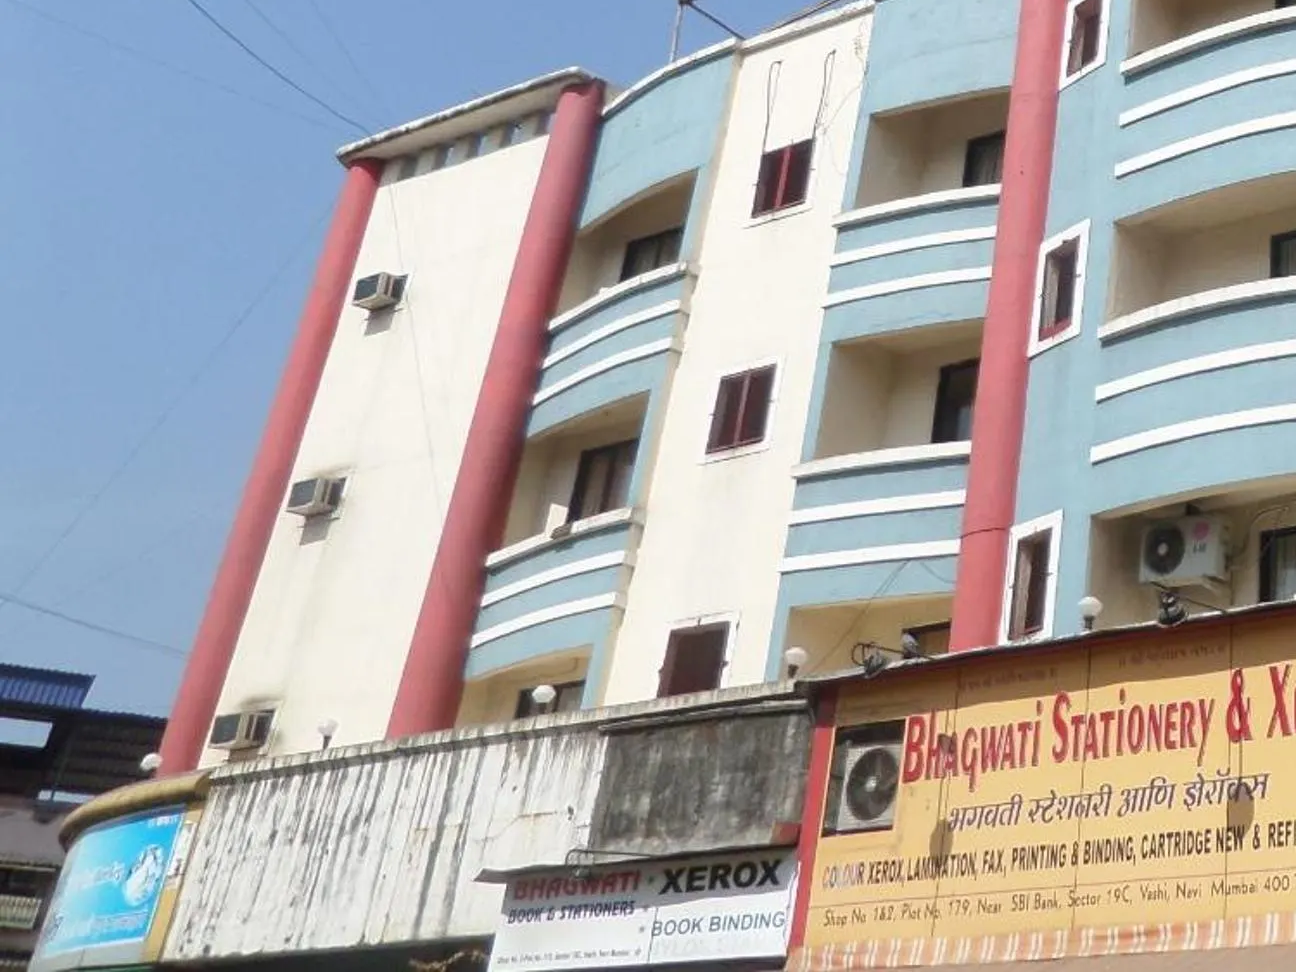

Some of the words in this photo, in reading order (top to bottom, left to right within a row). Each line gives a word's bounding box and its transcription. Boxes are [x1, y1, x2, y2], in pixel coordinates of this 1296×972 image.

[1226, 667, 1252, 744] &
[949, 793, 1022, 832] भगवती
[1117, 777, 1176, 817] आणि
[981, 847, 1007, 878] FAX,
[1011, 843, 1067, 872] PRINTING
[1071, 841, 1079, 866] &
[1083, 836, 1136, 866] BINDING,
[1141, 829, 1211, 860] CARTRIDGE
[1216, 824, 1245, 854] NEW
[1252, 823, 1261, 850] &
[513, 870, 641, 901] BHAGWATI
[658, 860, 782, 895] XEROX
[1011, 892, 1030, 912] SBI
[1067, 889, 1101, 908] Sector
[1176, 880, 1202, 900] Navi
[1264, 874, 1290, 892] 400
[507, 908, 543, 924] BOOK
[559, 900, 637, 920] STATIONERS
[652, 920, 703, 937] BOOK
[709, 911, 785, 932] BINDING
